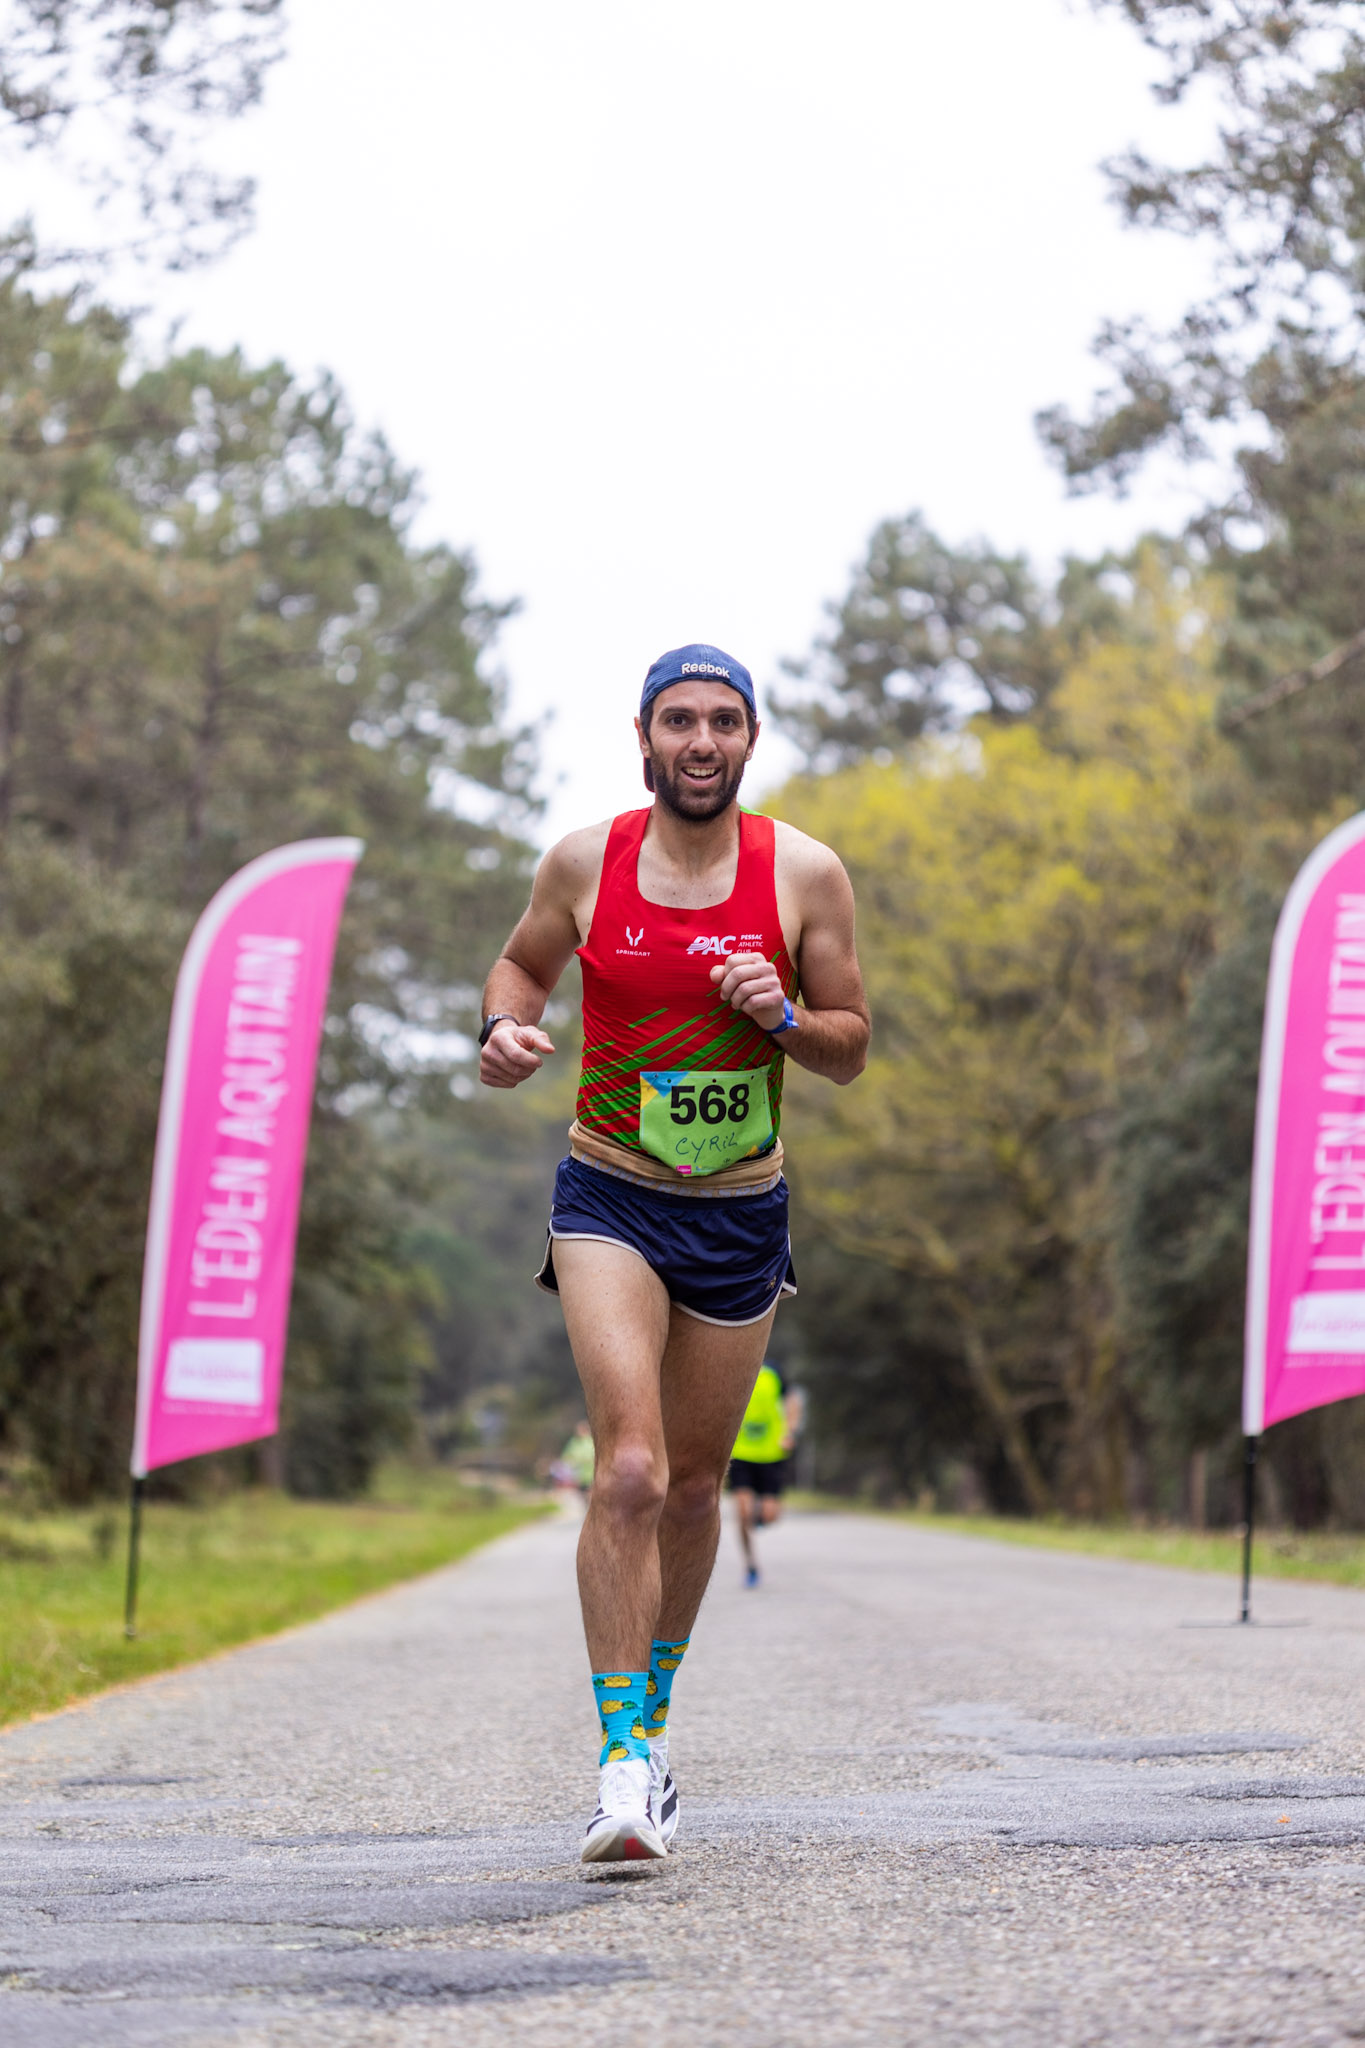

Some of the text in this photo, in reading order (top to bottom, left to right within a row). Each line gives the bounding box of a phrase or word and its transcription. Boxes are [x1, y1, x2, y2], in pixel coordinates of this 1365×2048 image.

[681, 662, 730, 679] Reebok
[615, 949, 651, 957] SPRINGART
[686, 935, 736, 956] PAC
[216, 933, 303, 1146] AQUITAIN
[670, 1083, 750, 1125] 568
[188, 1155, 270, 1319] L'EDEN
